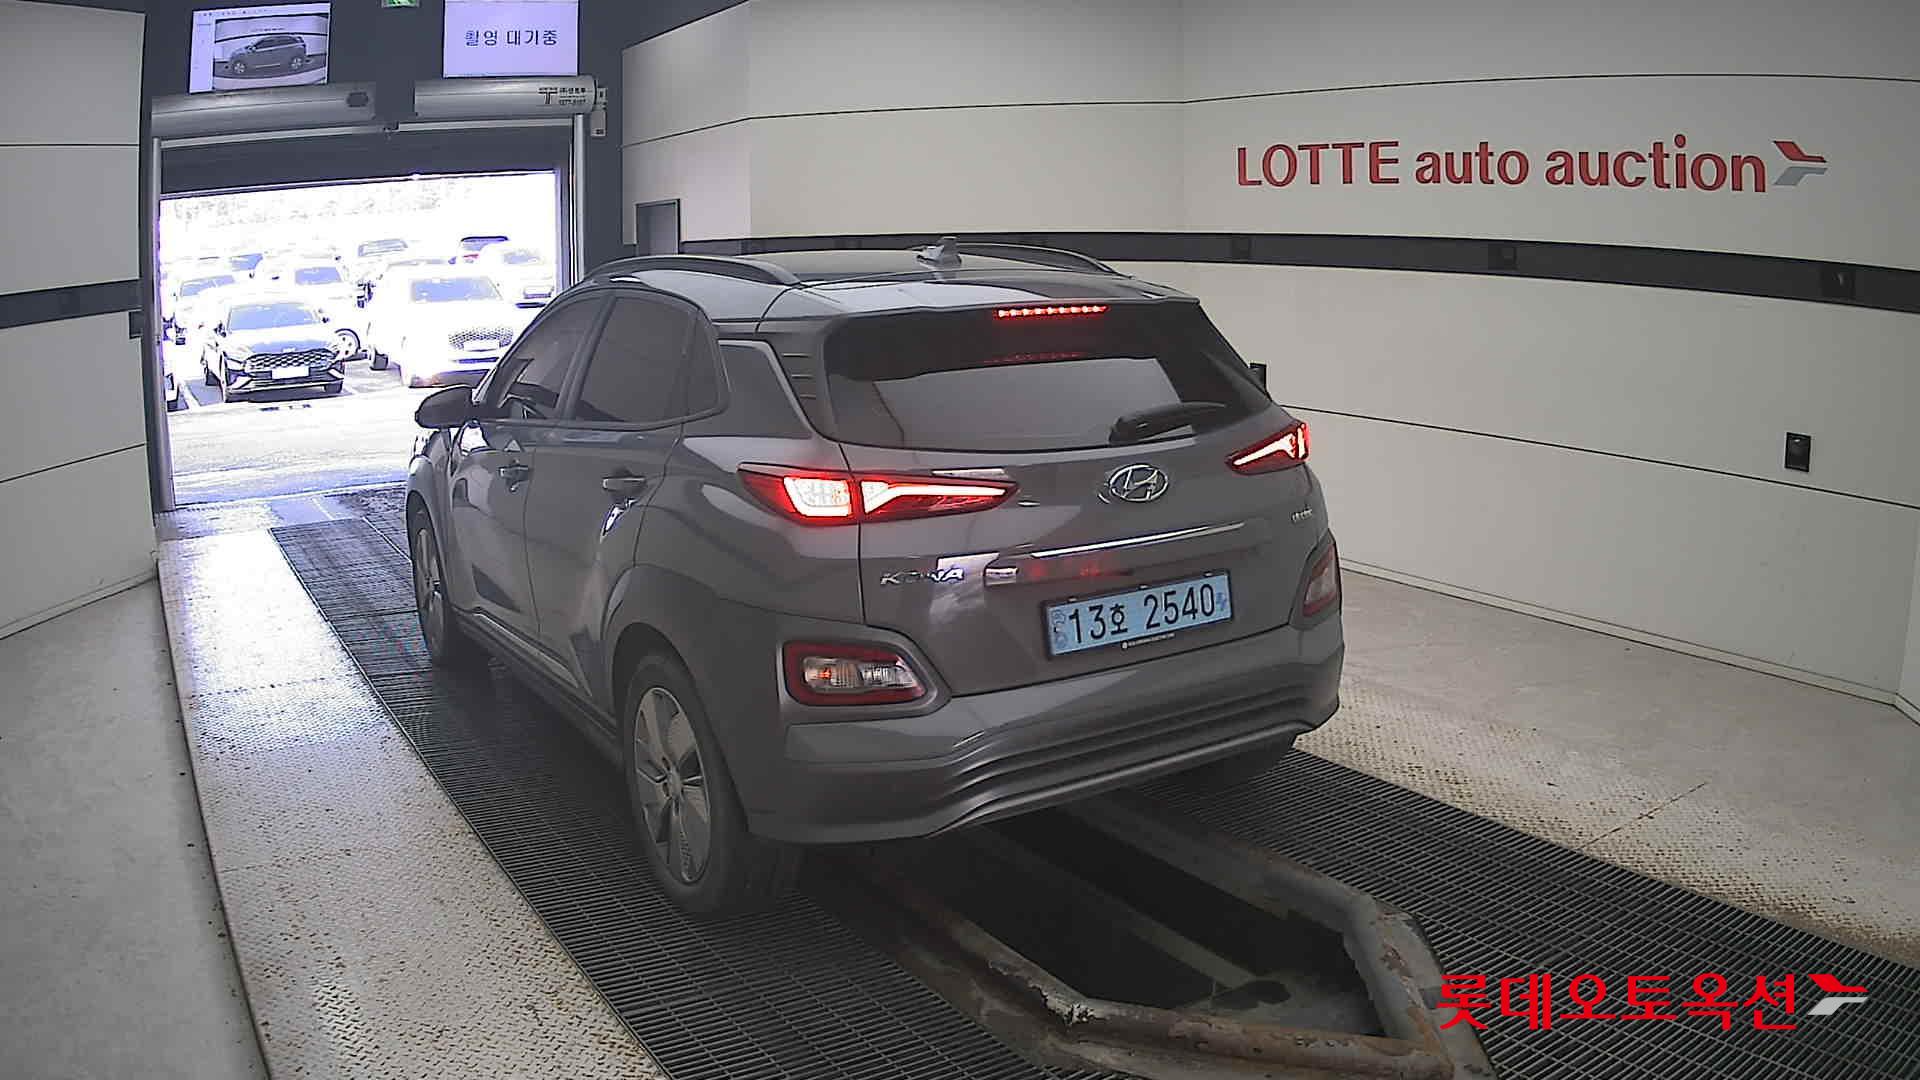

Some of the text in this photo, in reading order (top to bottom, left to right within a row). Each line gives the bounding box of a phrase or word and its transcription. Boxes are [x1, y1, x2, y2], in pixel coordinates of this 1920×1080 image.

[507, 30, 557, 46] 대기중
[1236, 133, 1767, 193] LOTTE auto auction
[1068, 583, 1215, 644] 13호 2540
